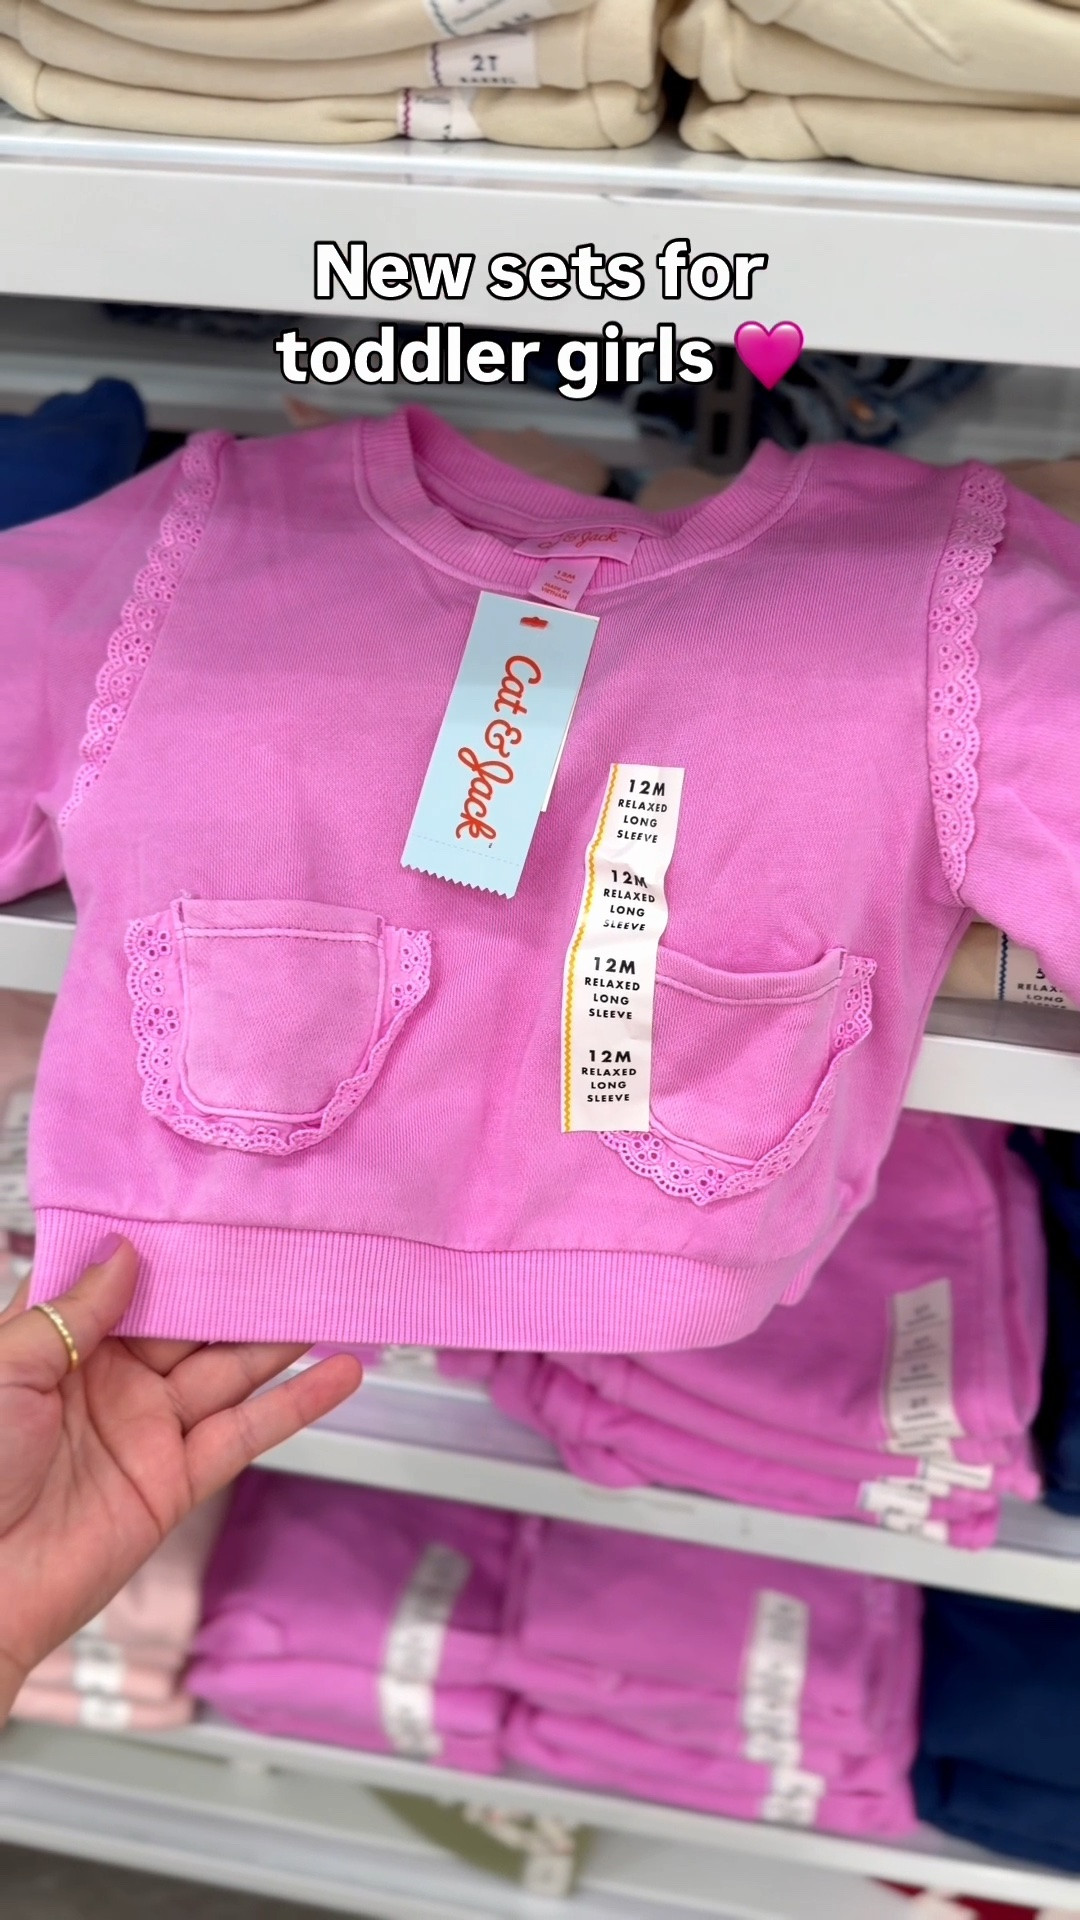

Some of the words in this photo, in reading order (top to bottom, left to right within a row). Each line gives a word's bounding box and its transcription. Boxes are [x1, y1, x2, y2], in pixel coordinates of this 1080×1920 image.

[471, 55, 498, 71] 2T
[575, 530, 619, 549] Jack
[541, 586, 568, 600] VIETNAM
[494, 655, 542, 715] Cat
[484, 719, 522, 758] &
[455, 747, 514, 840] Jack
[629, 779, 666, 796] 12M
[617, 799, 668, 813] RELAXED
[623, 815, 658, 828] LONG
[617, 830, 658, 843] SLEEVE
[611, 870, 648, 888] 12M
[603, 888, 655, 903] RELAXED
[610, 905, 645, 917] LONG
[603, 919, 646, 931] SLEEVE
[594, 957, 636, 975] 12M
[584, 977, 640, 991] RELAXED
[1017, 983, 1062, 993] RELAX
[593, 993, 630, 1005] LONG
[1026, 994, 1064, 1003] LONG
[588, 1008, 632, 1020] SLEEVE
[589, 1050, 632, 1063] 12M
[581, 1067, 637, 1076] RELAXED
[591, 1081, 627, 1089] LONG
[587, 1094, 630, 1102] SLEEVE
